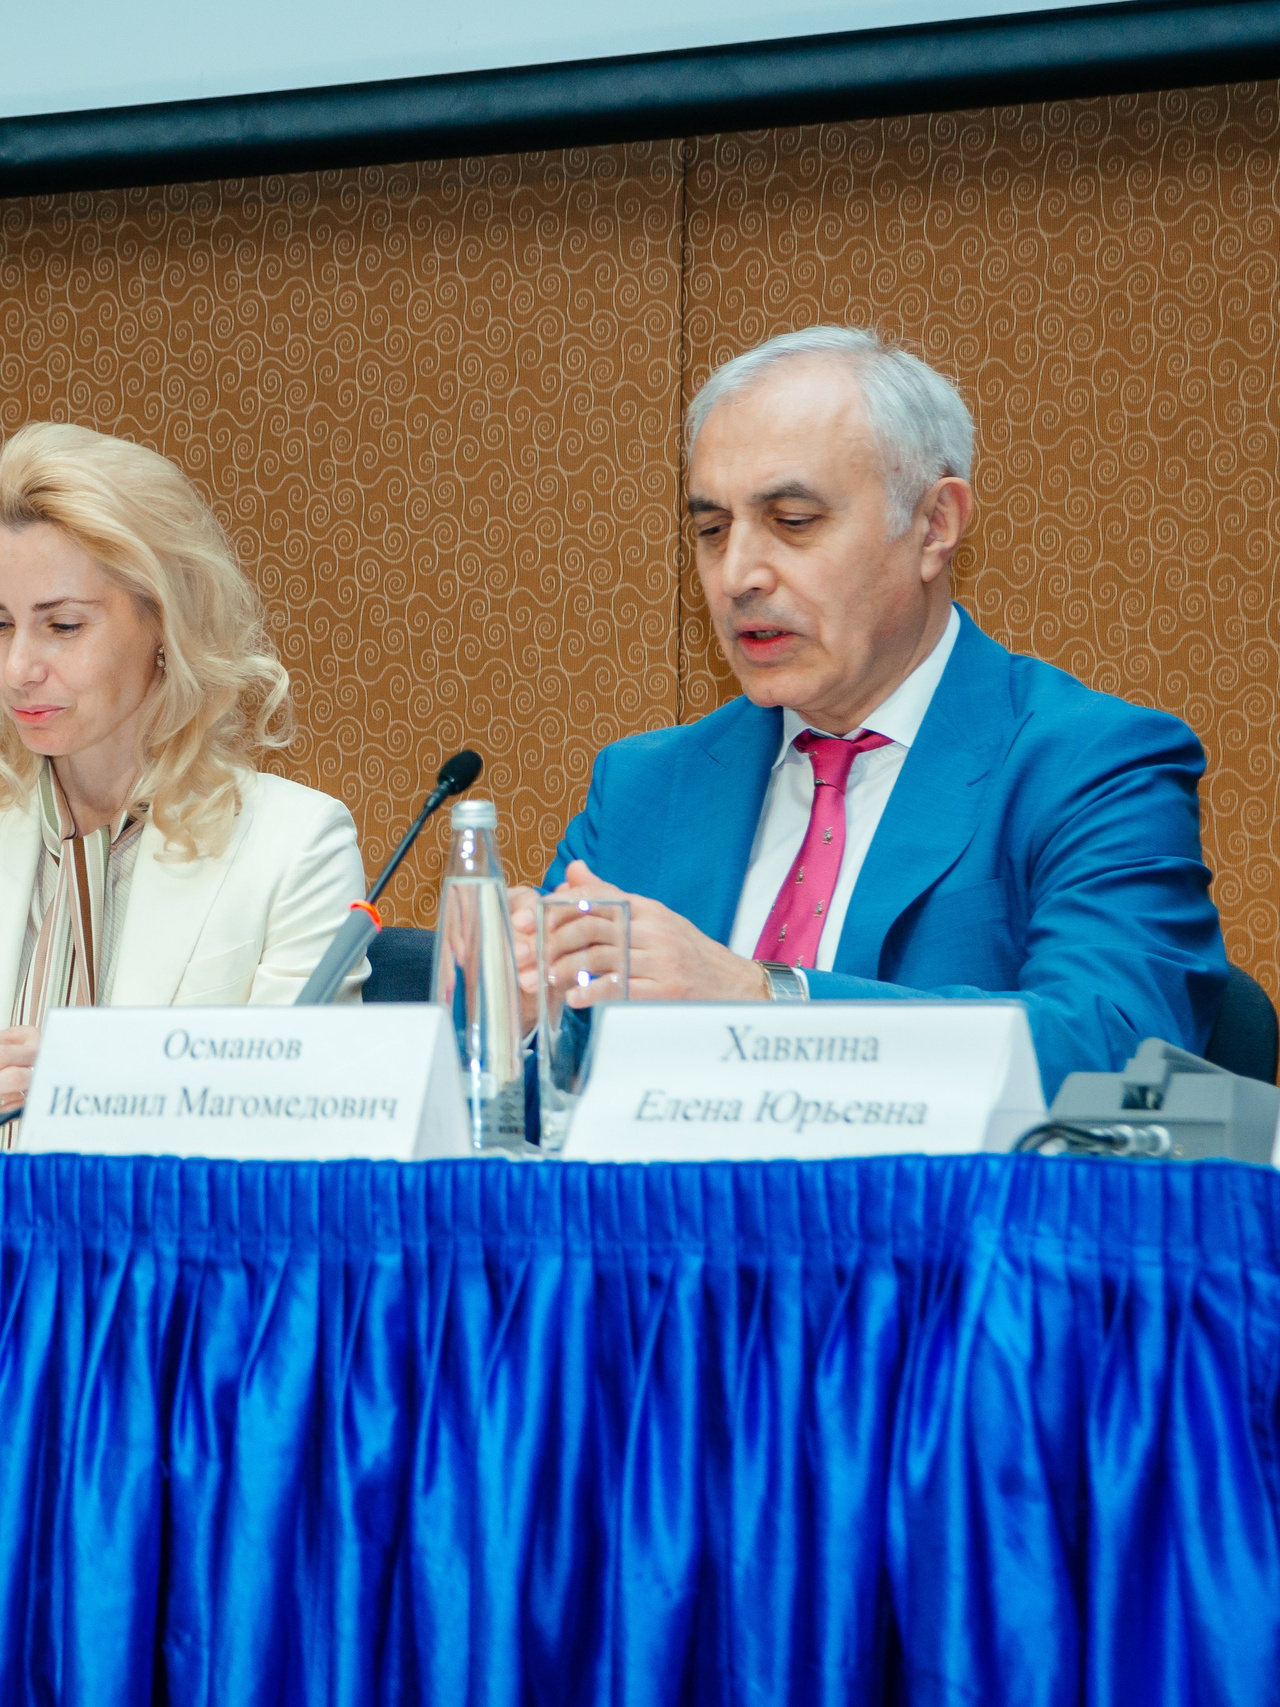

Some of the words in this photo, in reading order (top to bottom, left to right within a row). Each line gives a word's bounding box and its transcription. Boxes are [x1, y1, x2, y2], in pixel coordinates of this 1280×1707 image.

[163, 1029, 302, 1060] Османов
[721, 1025, 880, 1063] Хавкина
[47, 1086, 167, 1117] Исмаил
[176, 1086, 398, 1120] Магомедович
[634, 1090, 743, 1122] Елена
[755, 1090, 928, 1133] Юрьевна
